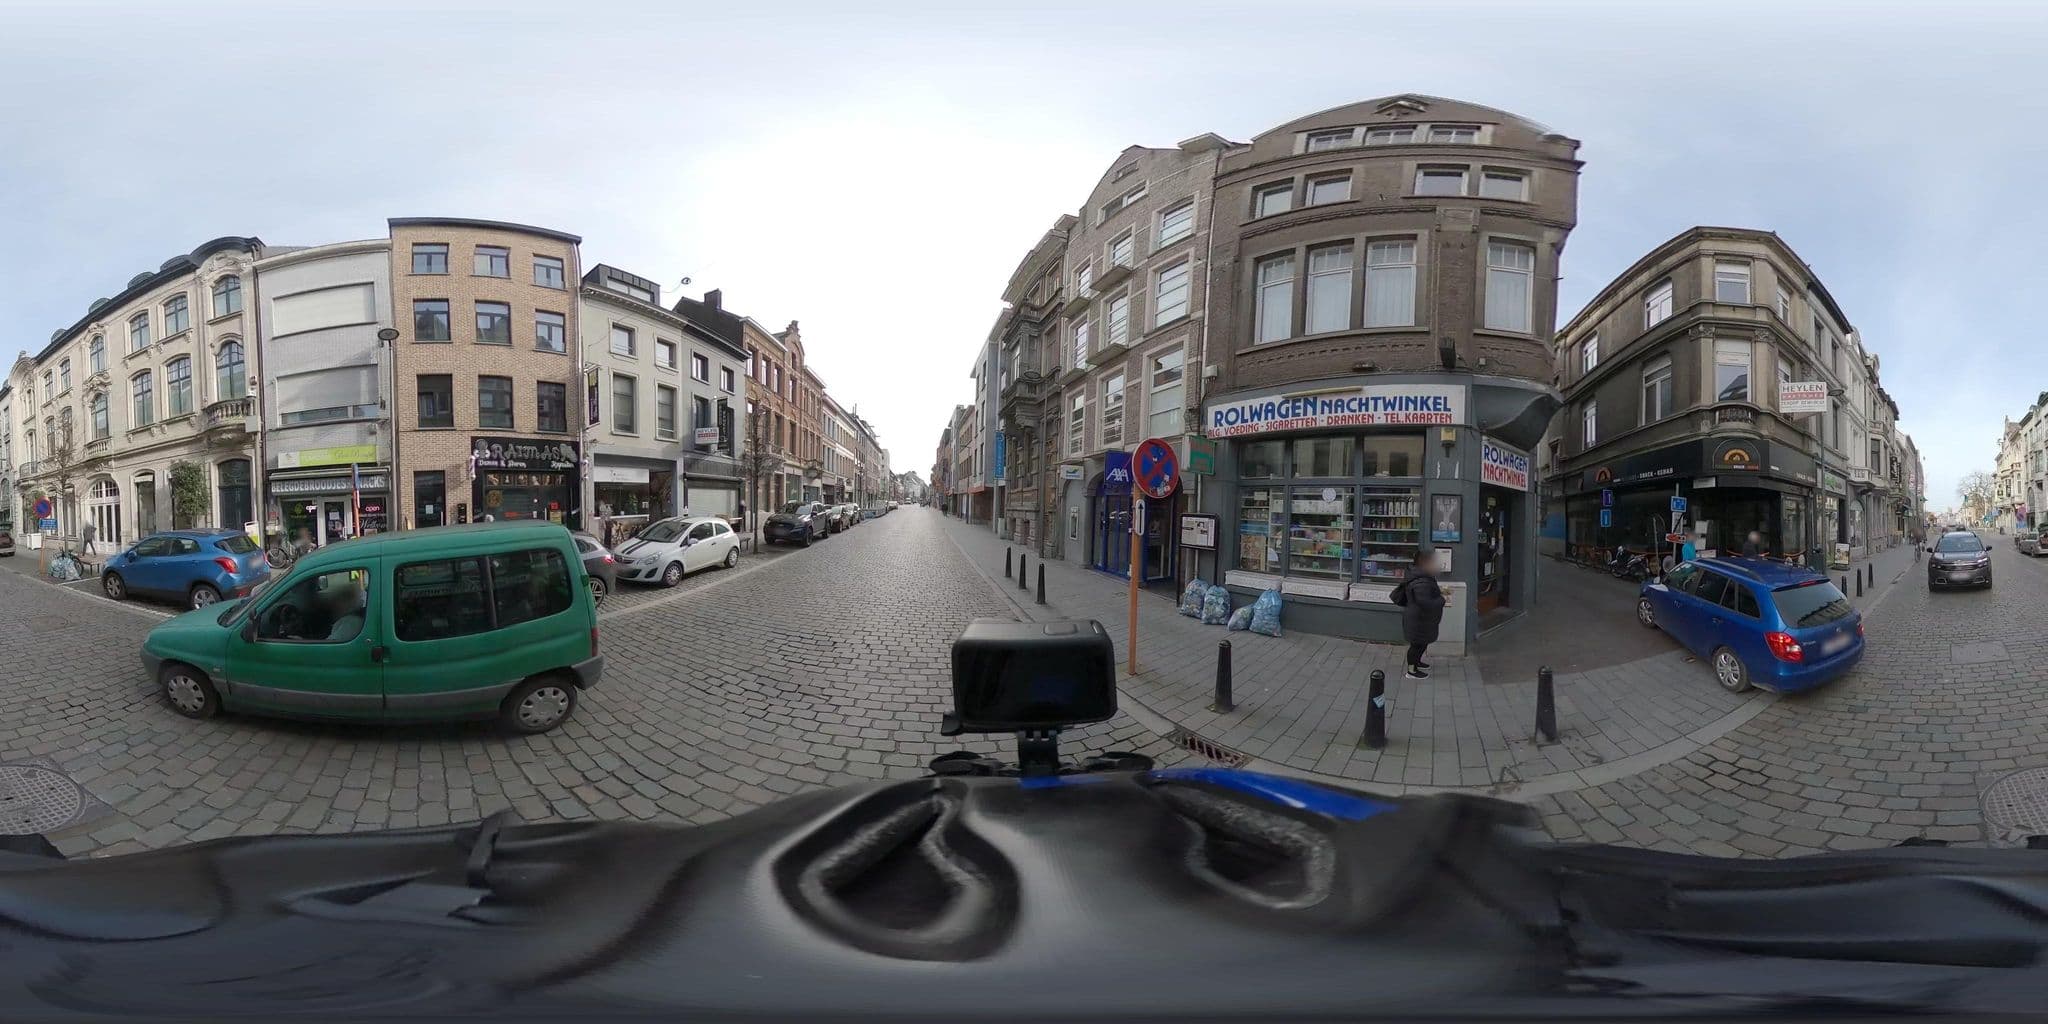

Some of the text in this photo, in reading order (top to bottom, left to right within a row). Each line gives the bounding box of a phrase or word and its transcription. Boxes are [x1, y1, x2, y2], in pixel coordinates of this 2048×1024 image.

[1782, 384, 1823, 393] HEYLEN
[1214, 396, 1451, 427] ROLWAGEN NACHTWINKEL
[1224, 423, 1259, 435] VOEDING
[1327, 414, 1375, 425] DRANKEN
[1384, 412, 1452, 424] TEL.KAARTEN
[1484, 444, 1528, 472] ROLWAGEN
[1106, 468, 1129, 482] AXA
[1483, 463, 1527, 488] NACHTWINKEL
